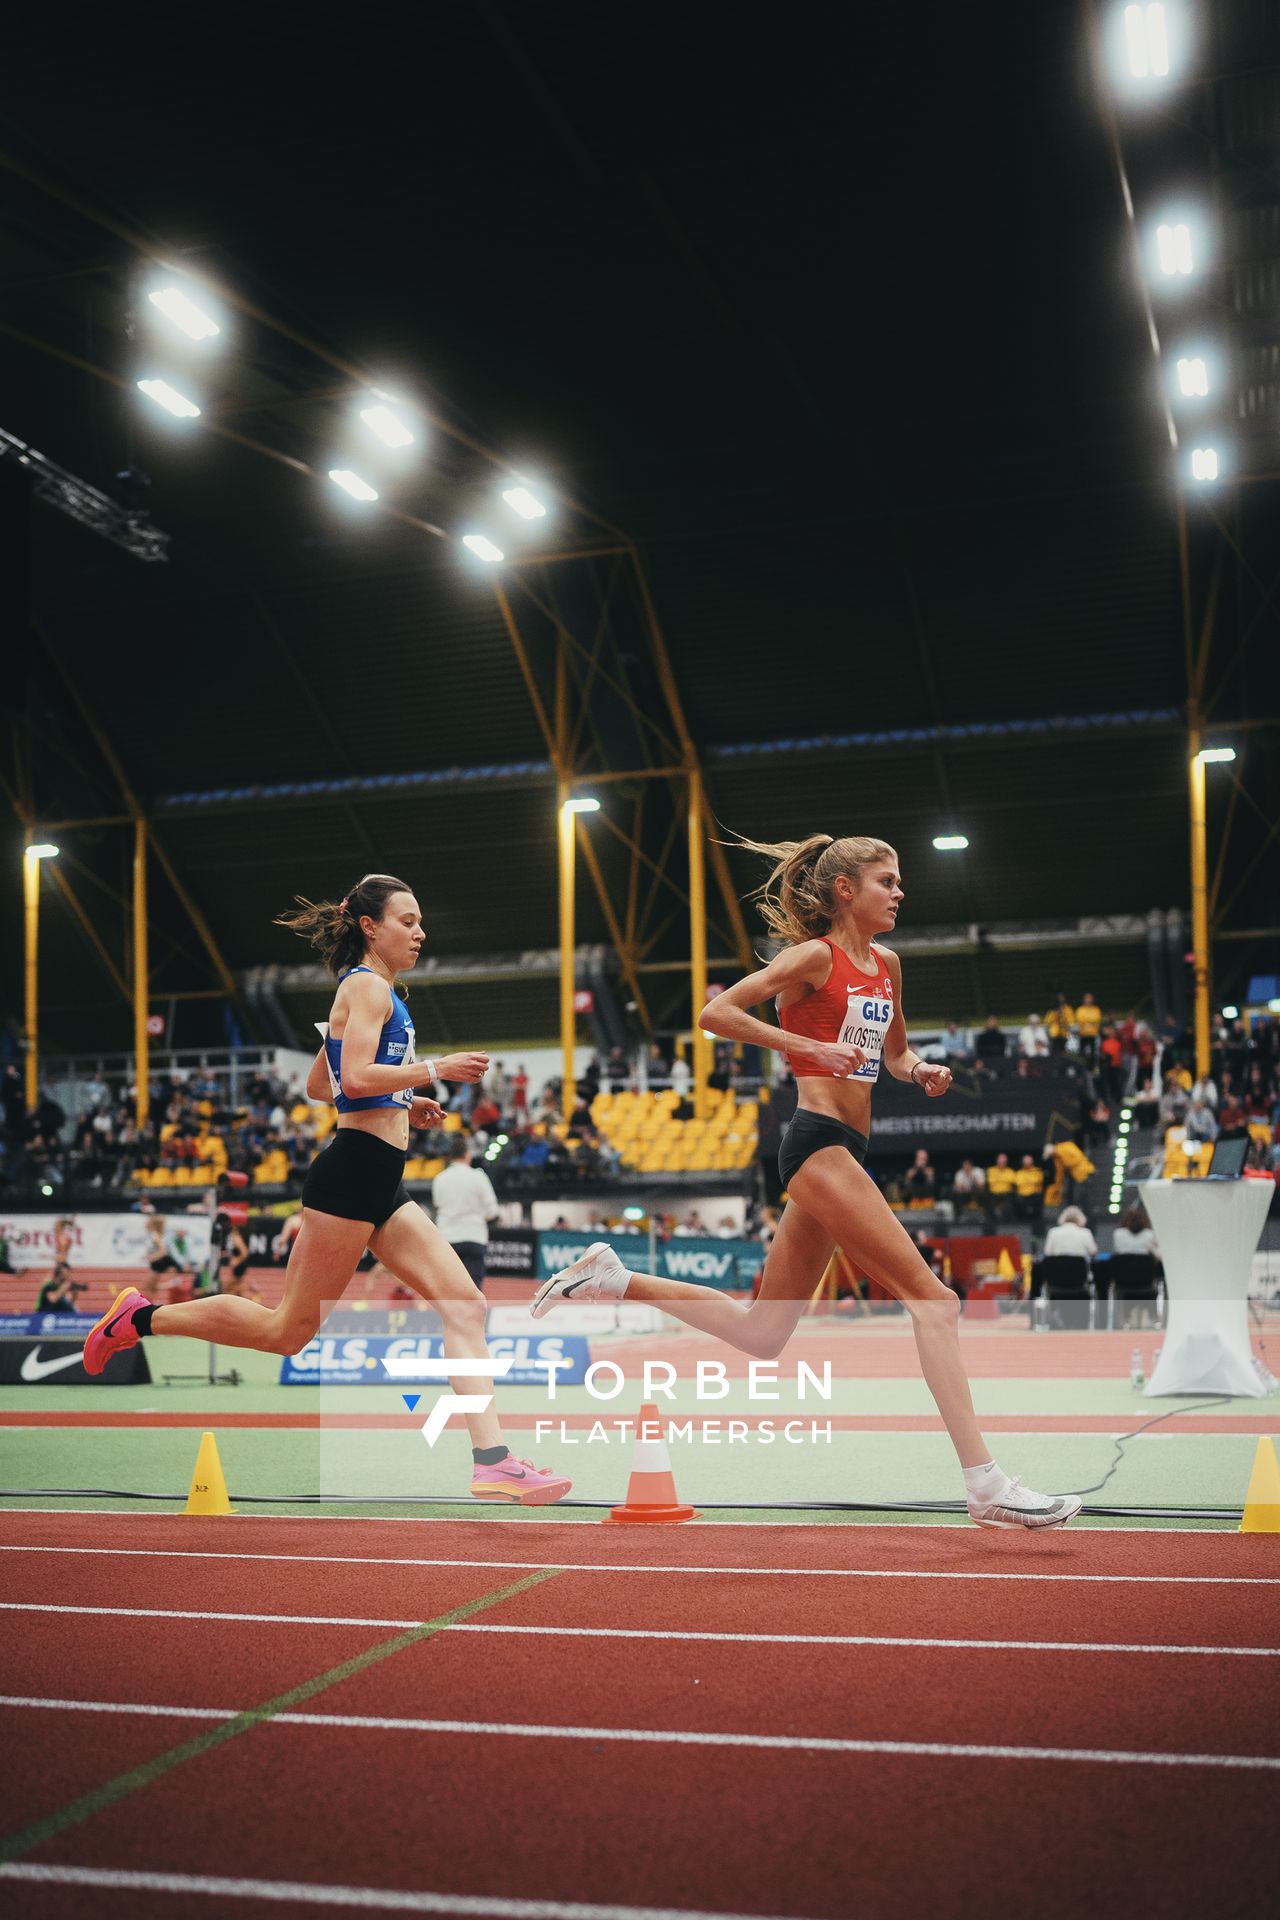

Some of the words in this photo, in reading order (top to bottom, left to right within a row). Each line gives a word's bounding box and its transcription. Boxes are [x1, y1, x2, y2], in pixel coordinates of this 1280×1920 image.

[862, 1001, 890, 1023] GLS
[871, 1113, 1036, 1135] MEISTERSCHAFTEN
[665, 1251, 732, 1278] WGV
